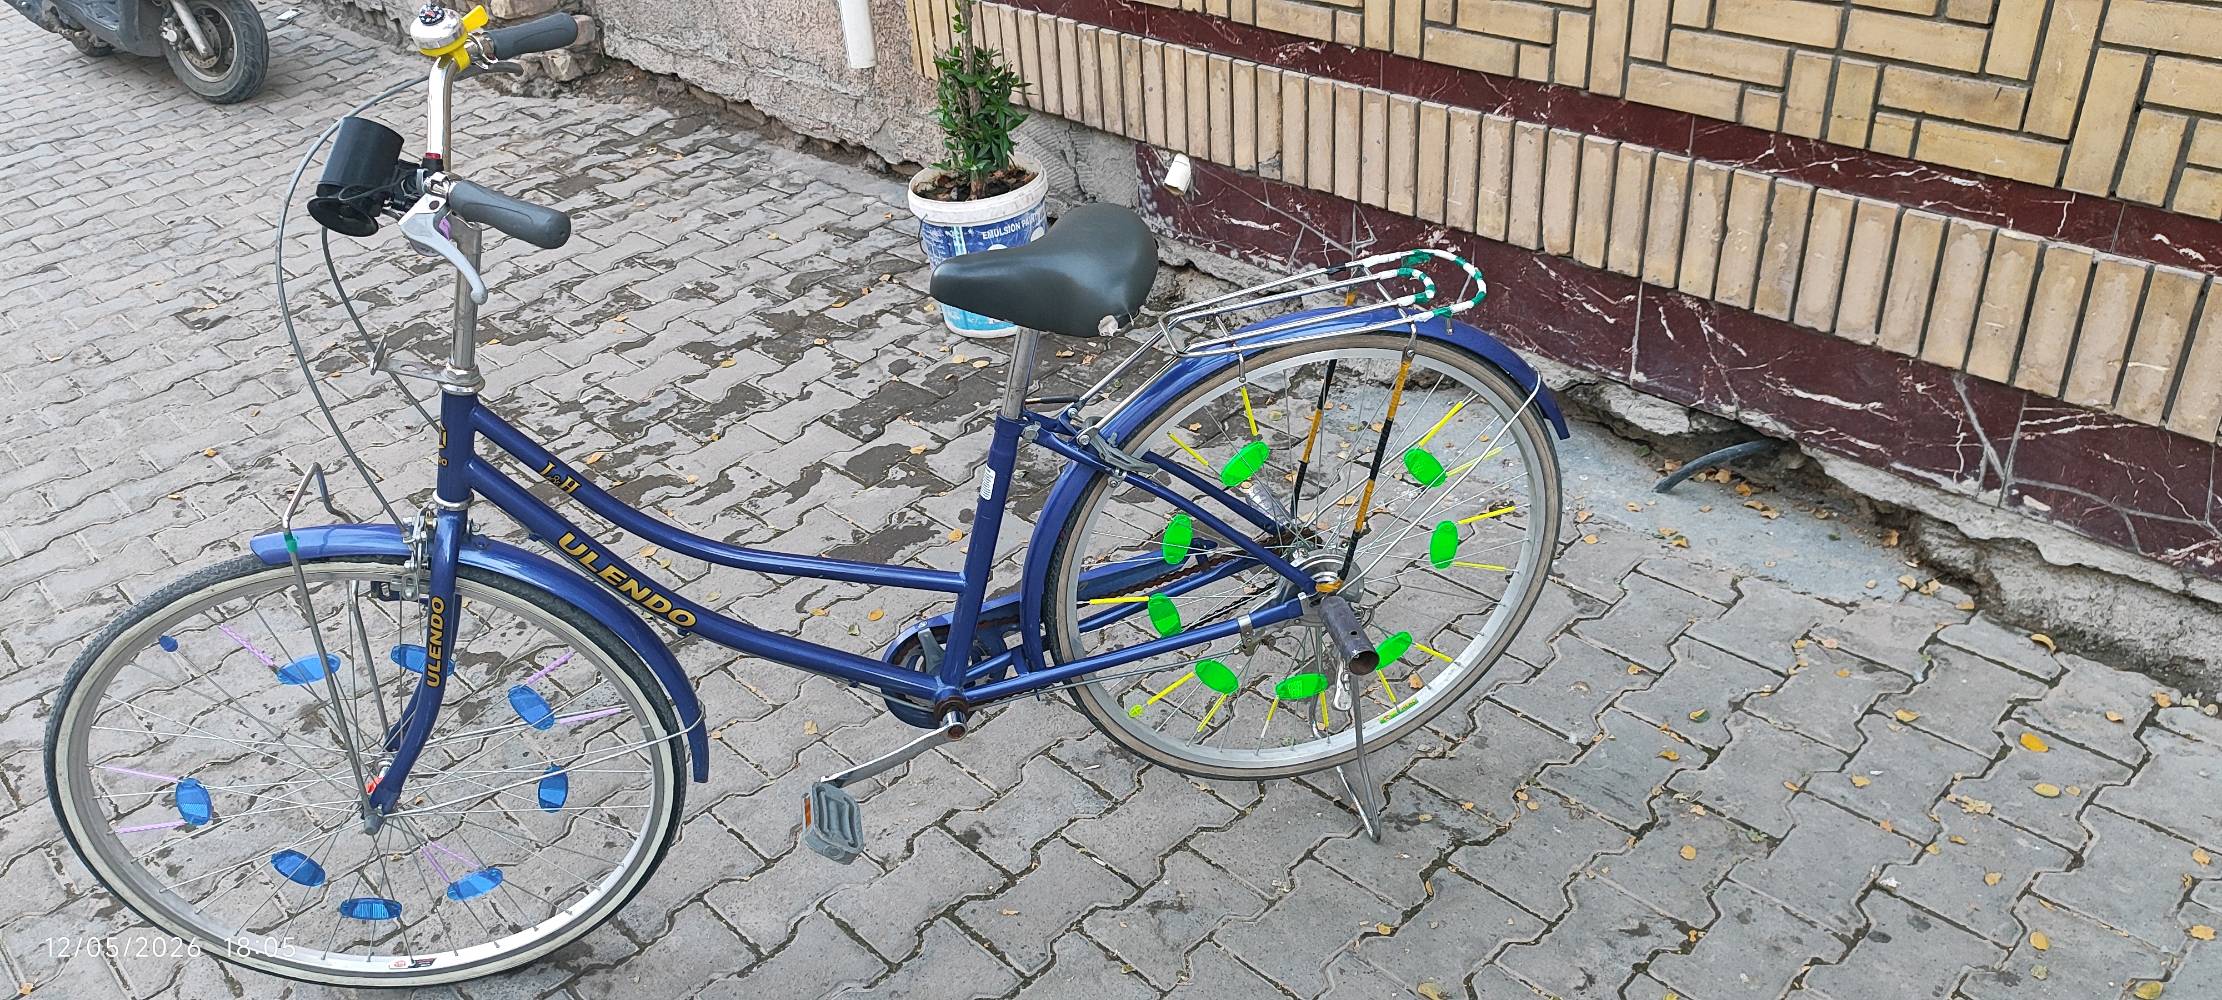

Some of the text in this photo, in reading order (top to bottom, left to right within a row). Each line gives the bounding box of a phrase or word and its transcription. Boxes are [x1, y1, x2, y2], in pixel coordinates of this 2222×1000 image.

[982, 222, 1021, 240] EMULSION
[557, 531, 698, 628] ULENDO
[426, 596, 446, 688] ULENDO
